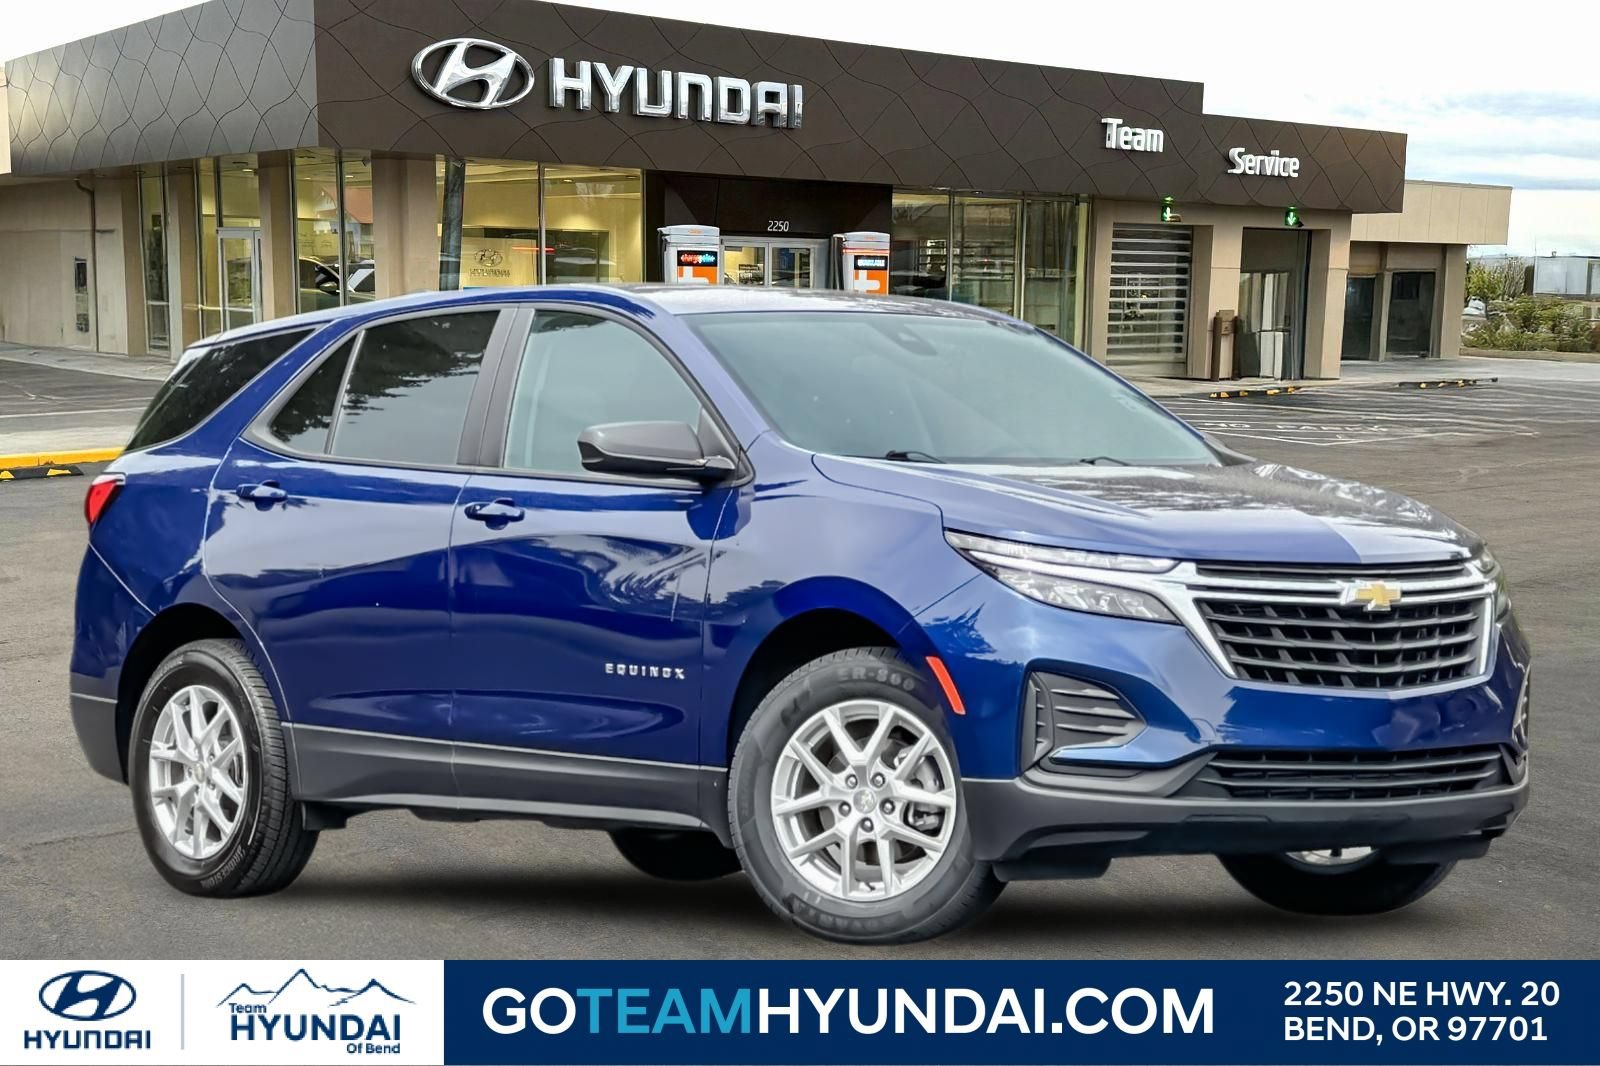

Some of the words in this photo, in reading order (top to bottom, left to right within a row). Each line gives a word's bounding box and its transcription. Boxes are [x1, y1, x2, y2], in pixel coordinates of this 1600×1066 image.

[549, 57, 803, 128] HYUNDAI
[1101, 117, 1164, 152] Team
[1227, 147, 1300, 178] Service
[767, 220, 790, 232] 2250
[605, 663, 685, 680] EQUINOX
